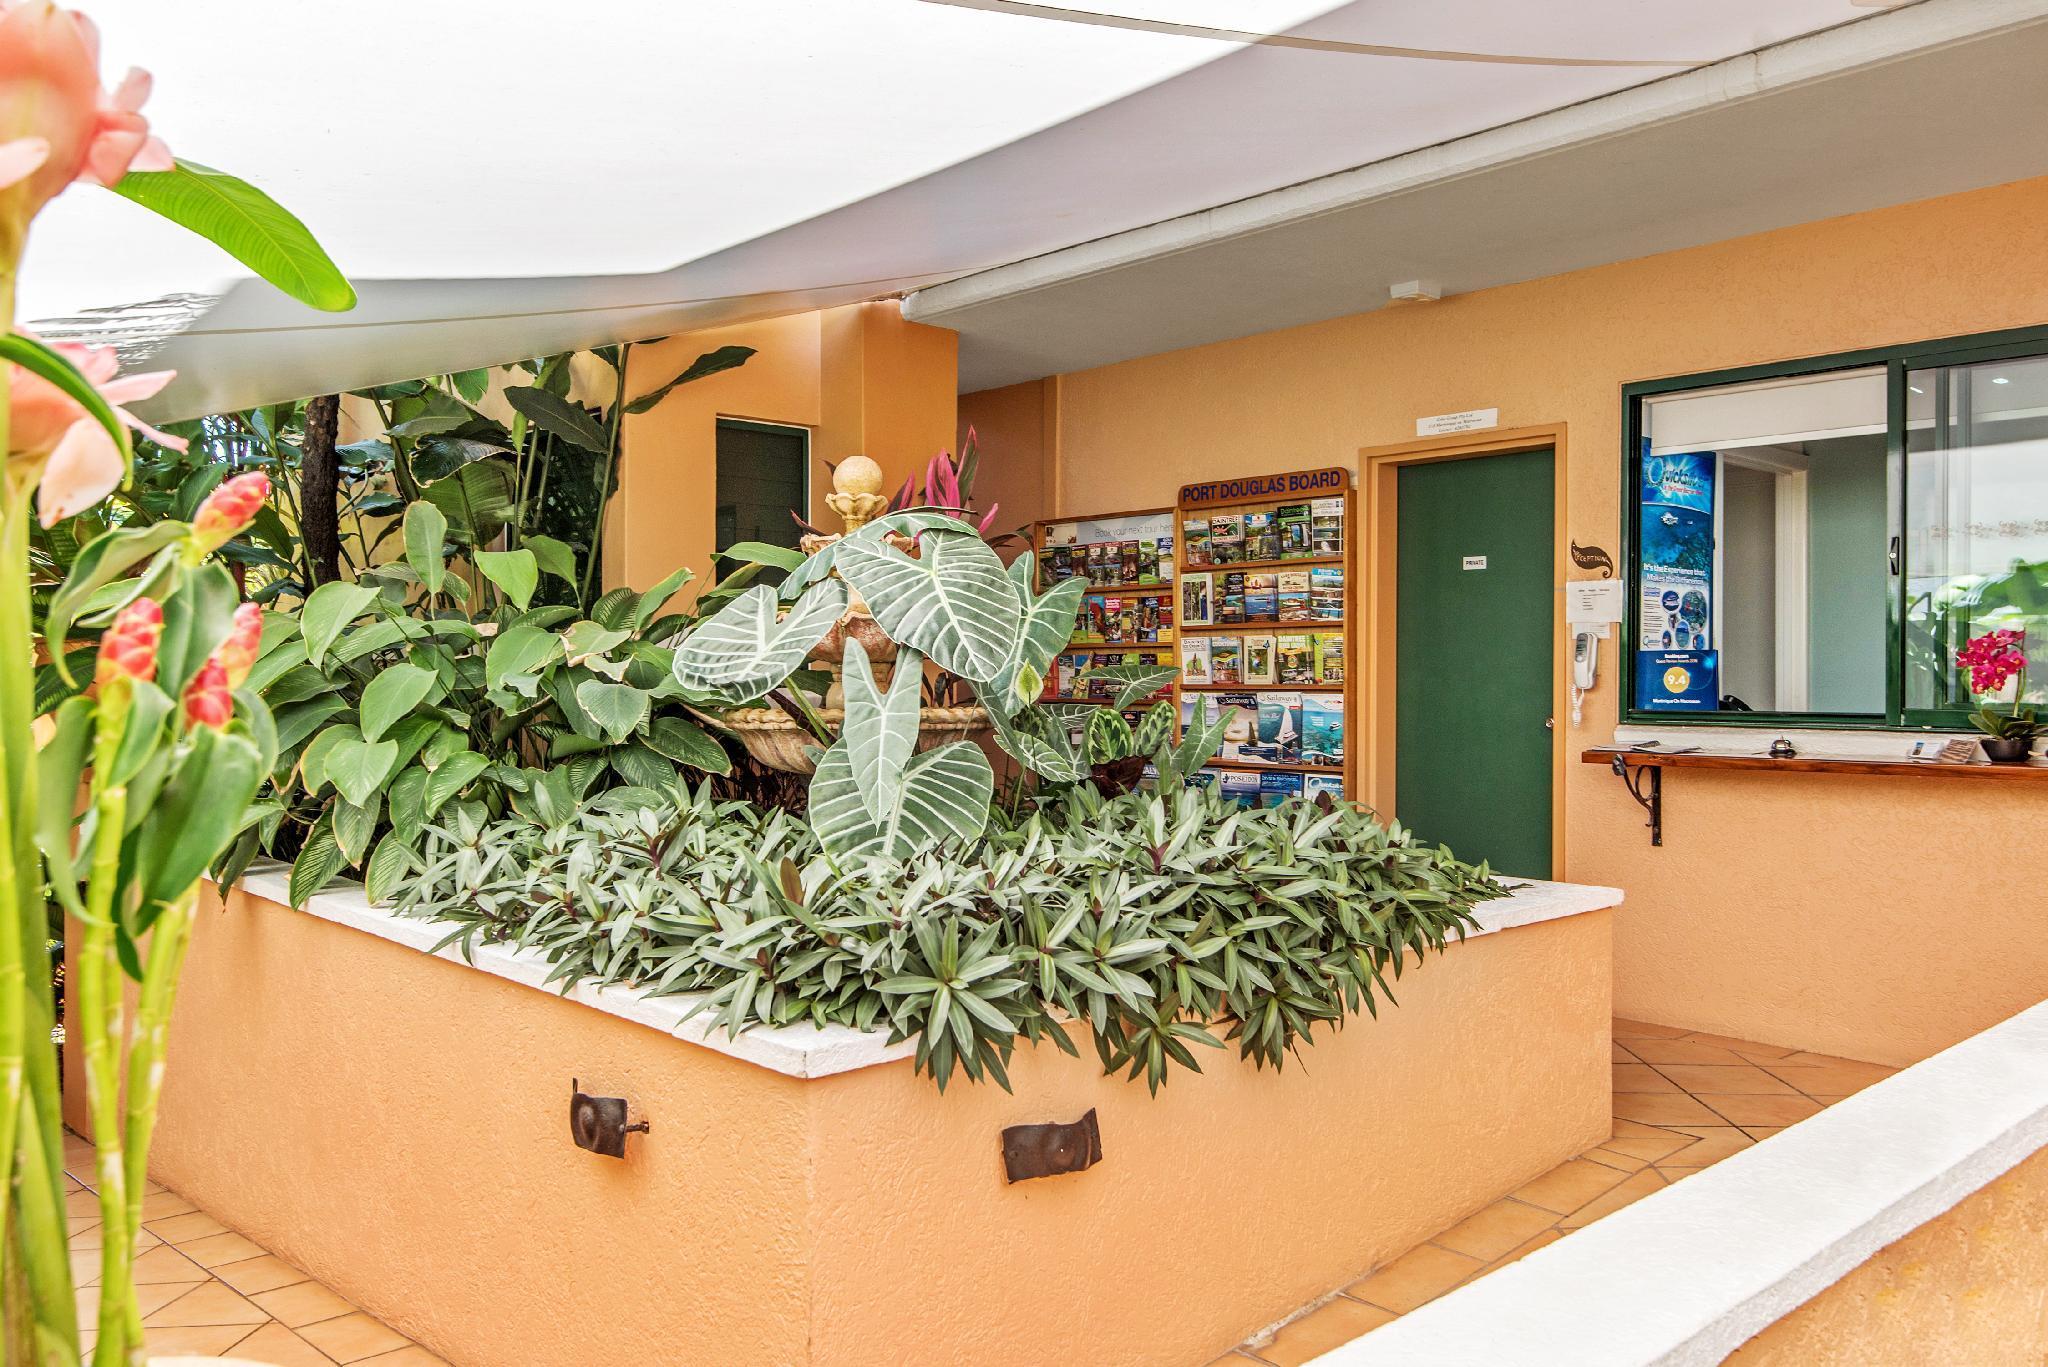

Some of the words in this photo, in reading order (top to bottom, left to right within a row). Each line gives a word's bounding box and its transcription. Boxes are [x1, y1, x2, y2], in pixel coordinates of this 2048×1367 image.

[1183, 485, 1217, 502] PORT
[1220, 477, 1286, 499] DOUGLAS
[1289, 471, 1341, 491] BOARD
[1095, 528, 1112, 538] Book
[1113, 527, 1127, 536] your
[1129, 526, 1143, 534] next
[1144, 523, 1159, 533] tour
[1160, 522, 1173, 532] here
[1663, 565, 1694, 575] Experience
[1647, 573, 1665, 582] Makes
[1665, 575, 1675, 583] the
[1667, 675, 1686, 685] 9.4
[1266, 694, 1292, 702] Sailaway
[1230, 775, 1258, 783] POSEIDON
